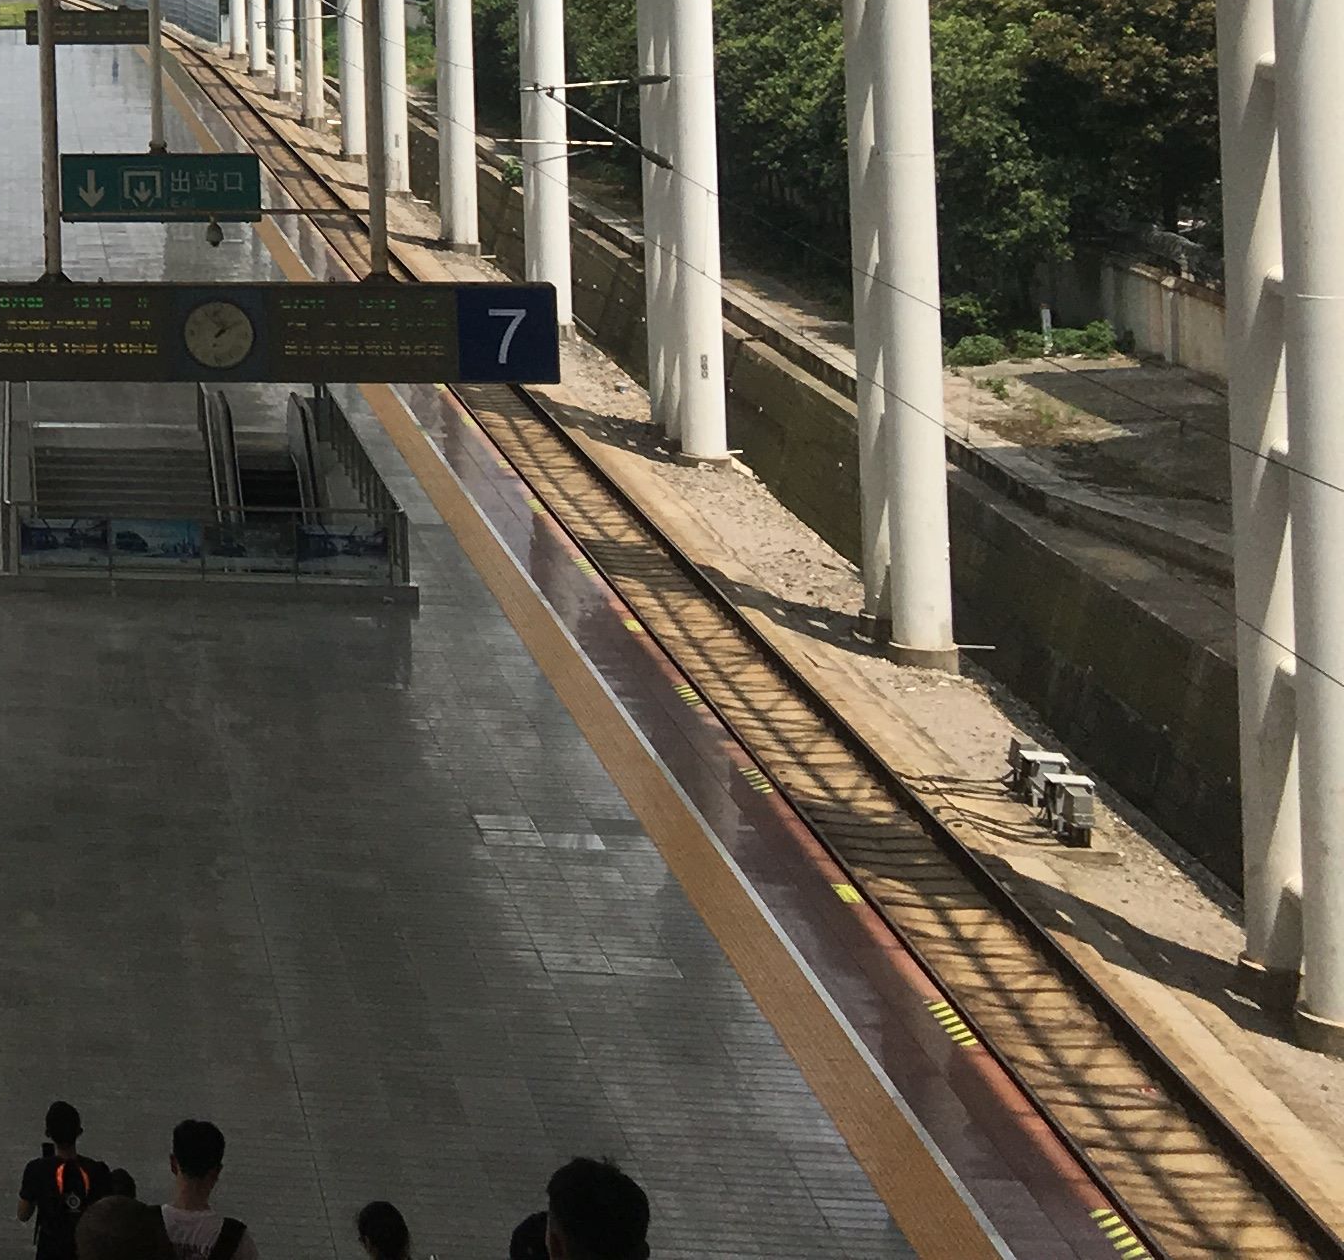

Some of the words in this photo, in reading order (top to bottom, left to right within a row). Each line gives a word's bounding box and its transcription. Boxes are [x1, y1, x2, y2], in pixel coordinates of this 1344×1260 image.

[171, 169, 243, 193] 出站口
[488, 308, 526, 364] 7
